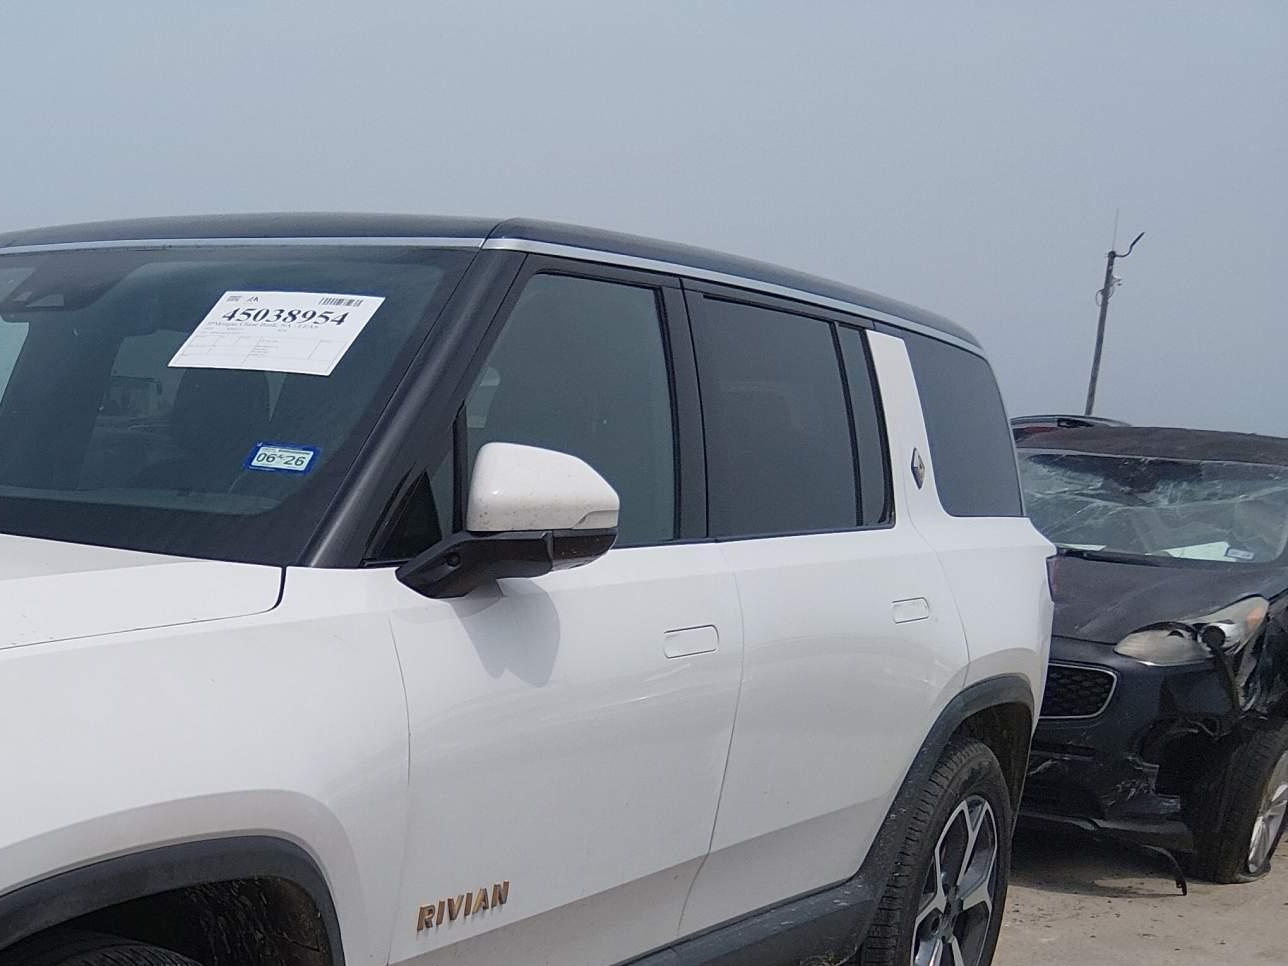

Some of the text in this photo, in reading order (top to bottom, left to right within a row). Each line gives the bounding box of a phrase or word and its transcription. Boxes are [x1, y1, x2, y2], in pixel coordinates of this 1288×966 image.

[223, 308, 349, 325] 45038954
[256, 452, 306, 466] 06 26
[417, 880, 510, 931] RIVIAN
